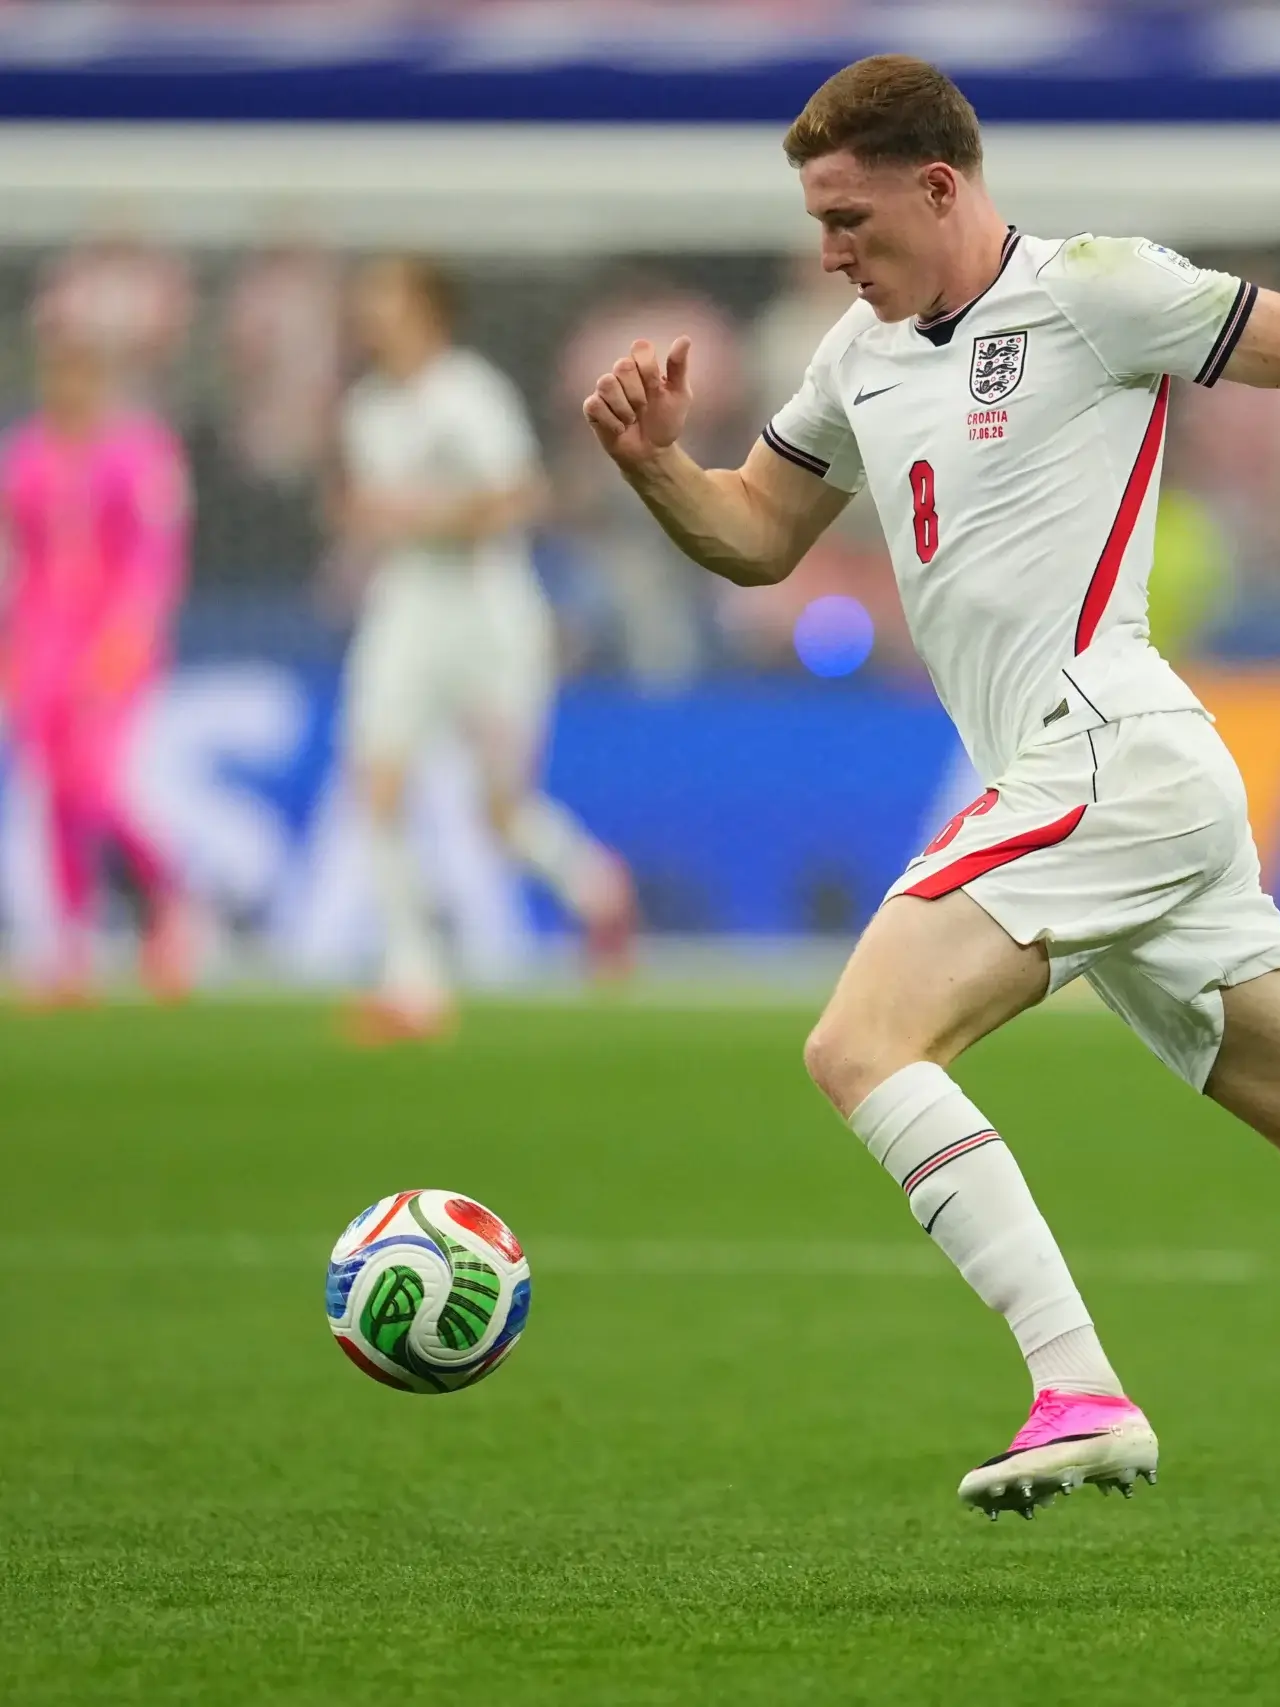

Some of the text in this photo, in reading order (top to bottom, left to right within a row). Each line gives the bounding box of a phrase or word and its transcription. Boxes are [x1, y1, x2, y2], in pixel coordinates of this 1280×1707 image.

[967, 410, 1008, 426] CROATIA
[969, 425, 1004, 441] 17.06.26
[909, 459, 939, 564] 8
